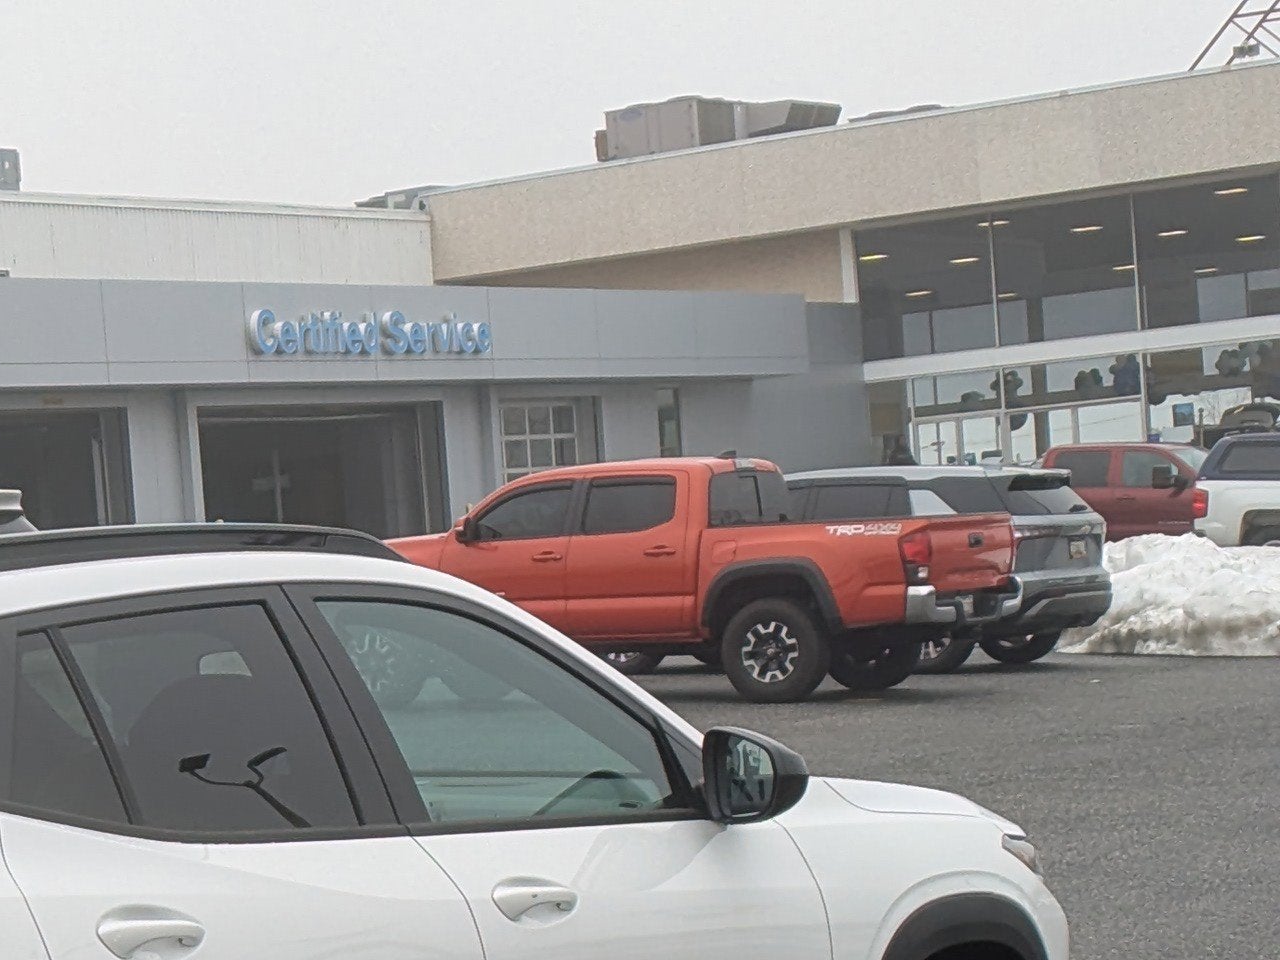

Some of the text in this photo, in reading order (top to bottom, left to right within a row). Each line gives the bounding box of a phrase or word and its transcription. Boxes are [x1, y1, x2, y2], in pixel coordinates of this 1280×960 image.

[250, 309, 492, 354] Certified Service
[825, 524, 865, 536] TRD
